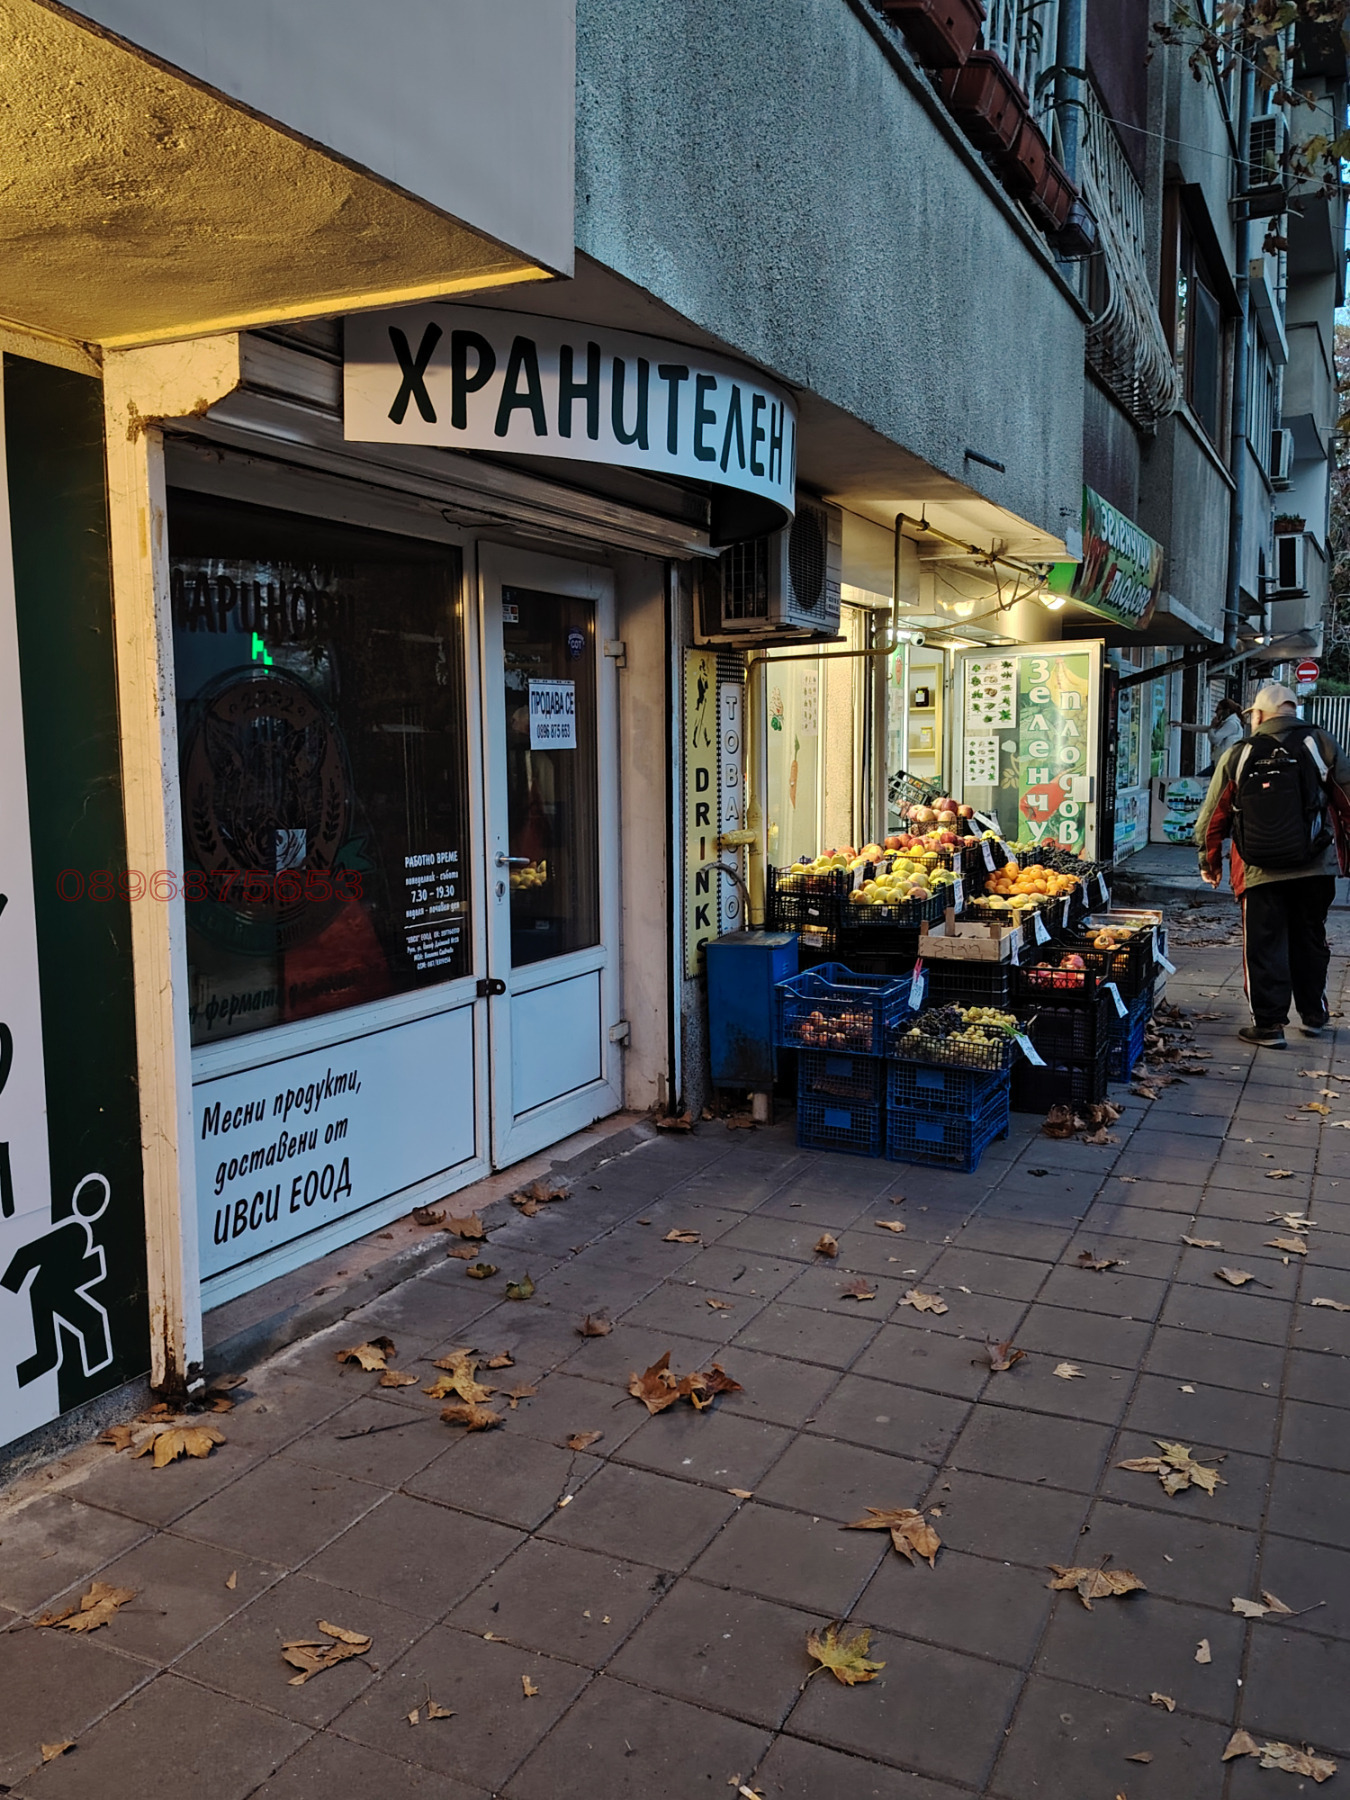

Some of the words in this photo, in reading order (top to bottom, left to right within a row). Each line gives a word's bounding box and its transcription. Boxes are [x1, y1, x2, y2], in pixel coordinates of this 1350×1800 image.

[531, 690, 564, 719] ПРОДАВА
[565, 692, 575, 715] СЕ
[405, 853, 436, 869] РАБОТНО
[436, 850, 459, 864] ВРЕМЕ
[202, 1102, 265, 1140] Месни
[273, 1068, 362, 1122] продукти,
[215, 1130, 317, 1195] доставени
[324, 1115, 348, 1144] от
[214, 1184, 281, 1245] ИВСИ
[290, 1156, 352, 1214] ЕООД
